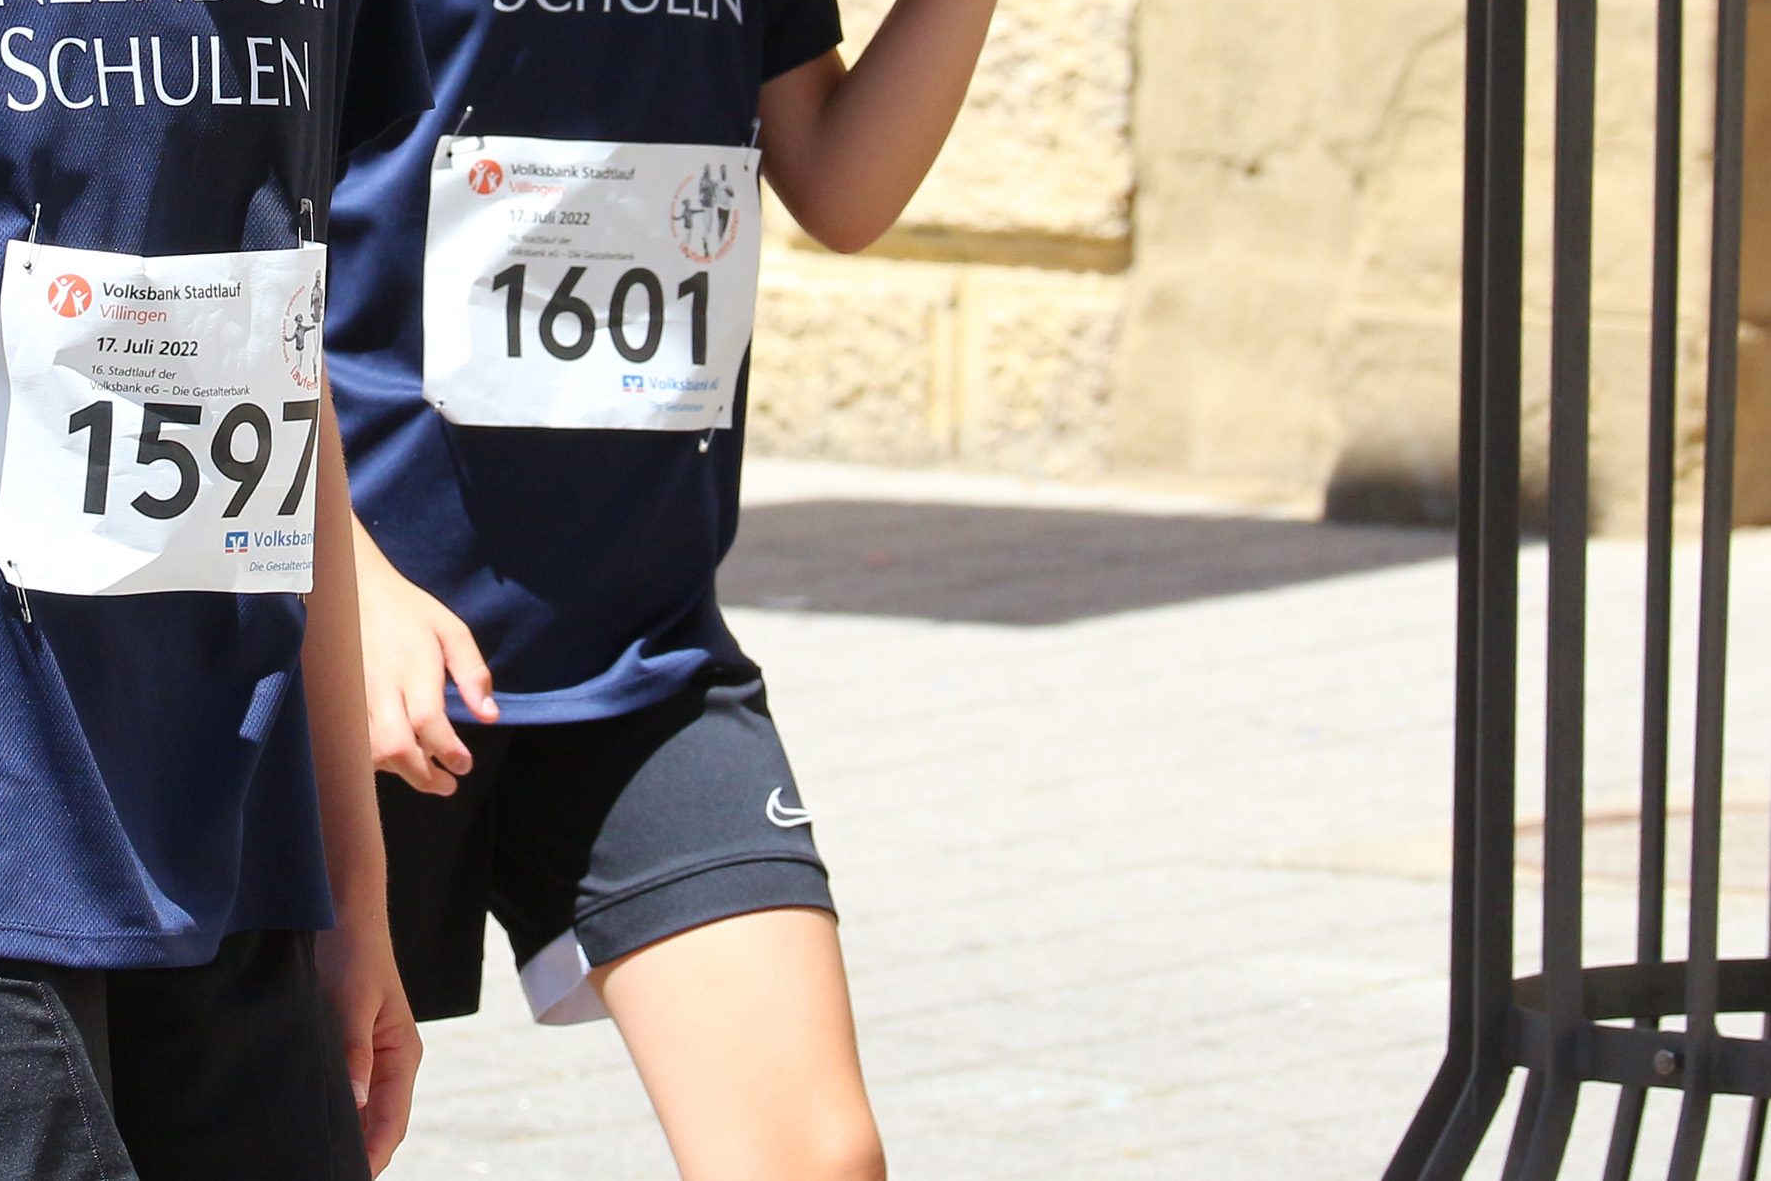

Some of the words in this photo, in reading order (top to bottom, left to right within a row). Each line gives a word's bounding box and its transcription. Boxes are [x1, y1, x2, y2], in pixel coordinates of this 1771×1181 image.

[0, 27, 310, 112] SCHULEN
[511, 163, 577, 177] Volksbank
[582, 166, 635, 180] Stadtlauf
[532, 210, 556, 224] Juli
[559, 211, 591, 225] 2022
[102, 282, 182, 301] Volksbank
[184, 282, 242, 300] Stadtlauf
[100, 304, 168, 325] Villingen
[492, 264, 709, 366] 1601
[96, 337, 118, 353] 17.
[123, 338, 154, 355] Juli
[158, 340, 199, 357] 2022
[91, 365, 106, 375] 16.
[108, 365, 157, 379] Stadtlauf
[158, 368, 177, 380] der
[90, 380, 142, 394] Volksbank
[144, 385, 160, 395] eG
[172, 385, 190, 396] Die
[192, 385, 251, 398] Gestalterbank
[68, 398, 319, 519] 1597
[249, 561, 264, 572] Die
